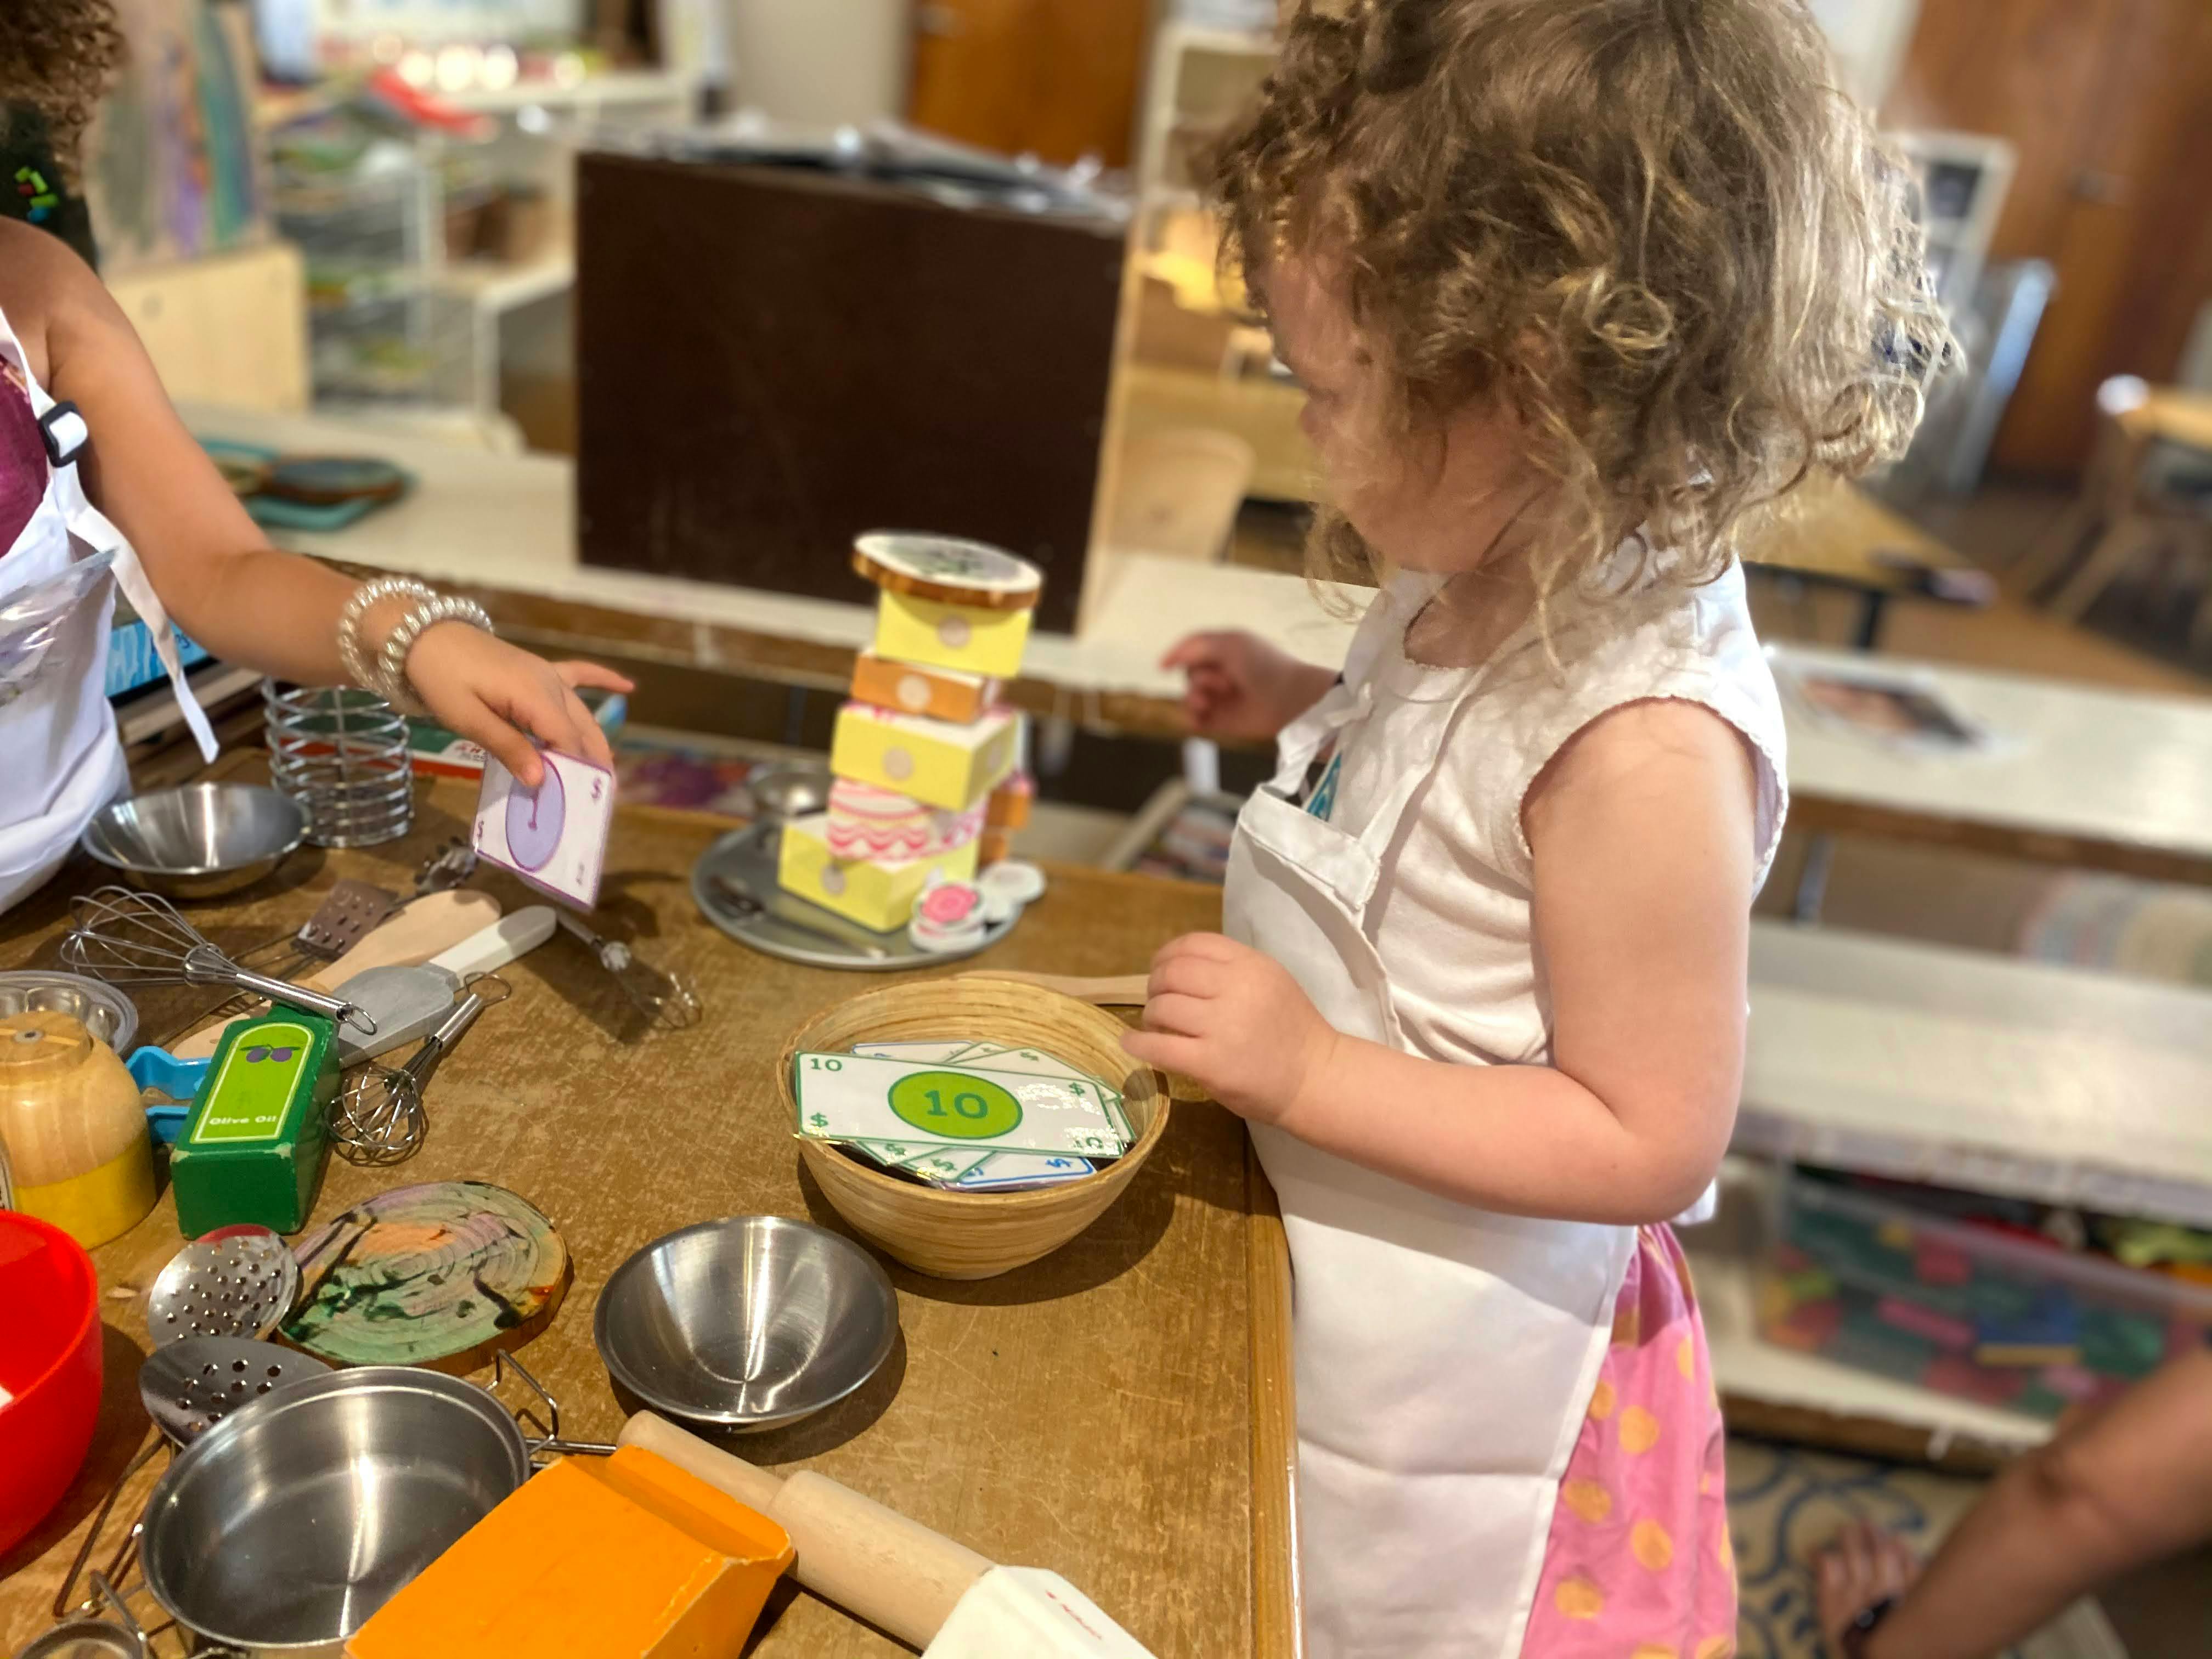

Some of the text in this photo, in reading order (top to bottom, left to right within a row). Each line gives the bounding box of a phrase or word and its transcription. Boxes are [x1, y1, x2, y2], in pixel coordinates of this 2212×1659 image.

[810, 1058, 842, 1071] 10
[924, 1090, 988, 1119] 10
[255, 1115, 276, 1123] Oil
[810, 1112, 828, 1127] $
